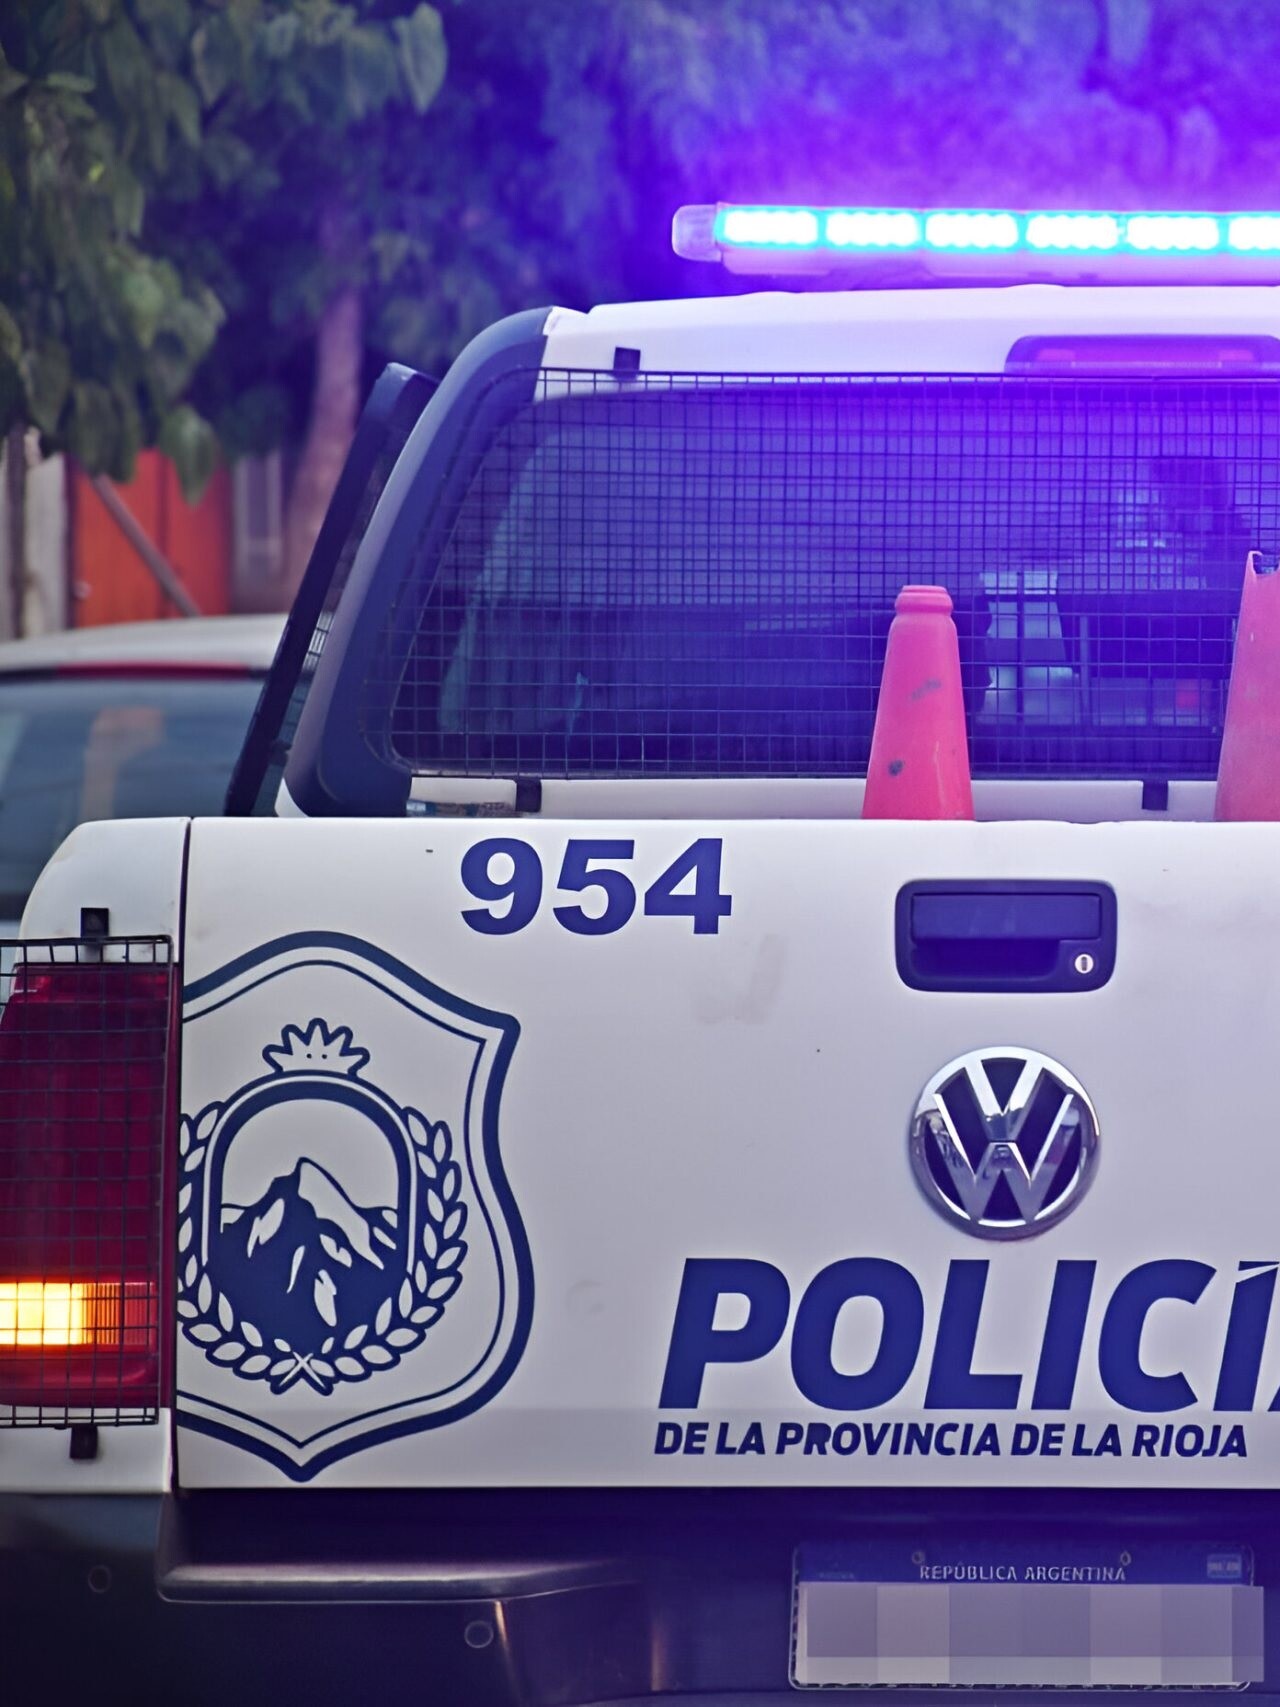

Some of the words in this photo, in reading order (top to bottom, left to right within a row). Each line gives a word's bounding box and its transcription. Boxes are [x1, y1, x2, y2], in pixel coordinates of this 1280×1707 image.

[459, 837, 733, 937] 954
[653, 1421, 710, 1455] DE
[714, 1421, 766, 1456] LA
[774, 1421, 1001, 1457] PROVINCIA
[1009, 1422, 1066, 1457] DE
[1071, 1423, 1123, 1457] LA
[1131, 1423, 1248, 1458] RIOJA
[920, 1562, 1018, 1581] REPÚBLICA
[1024, 1566, 1127, 1581] ARGENTINA
